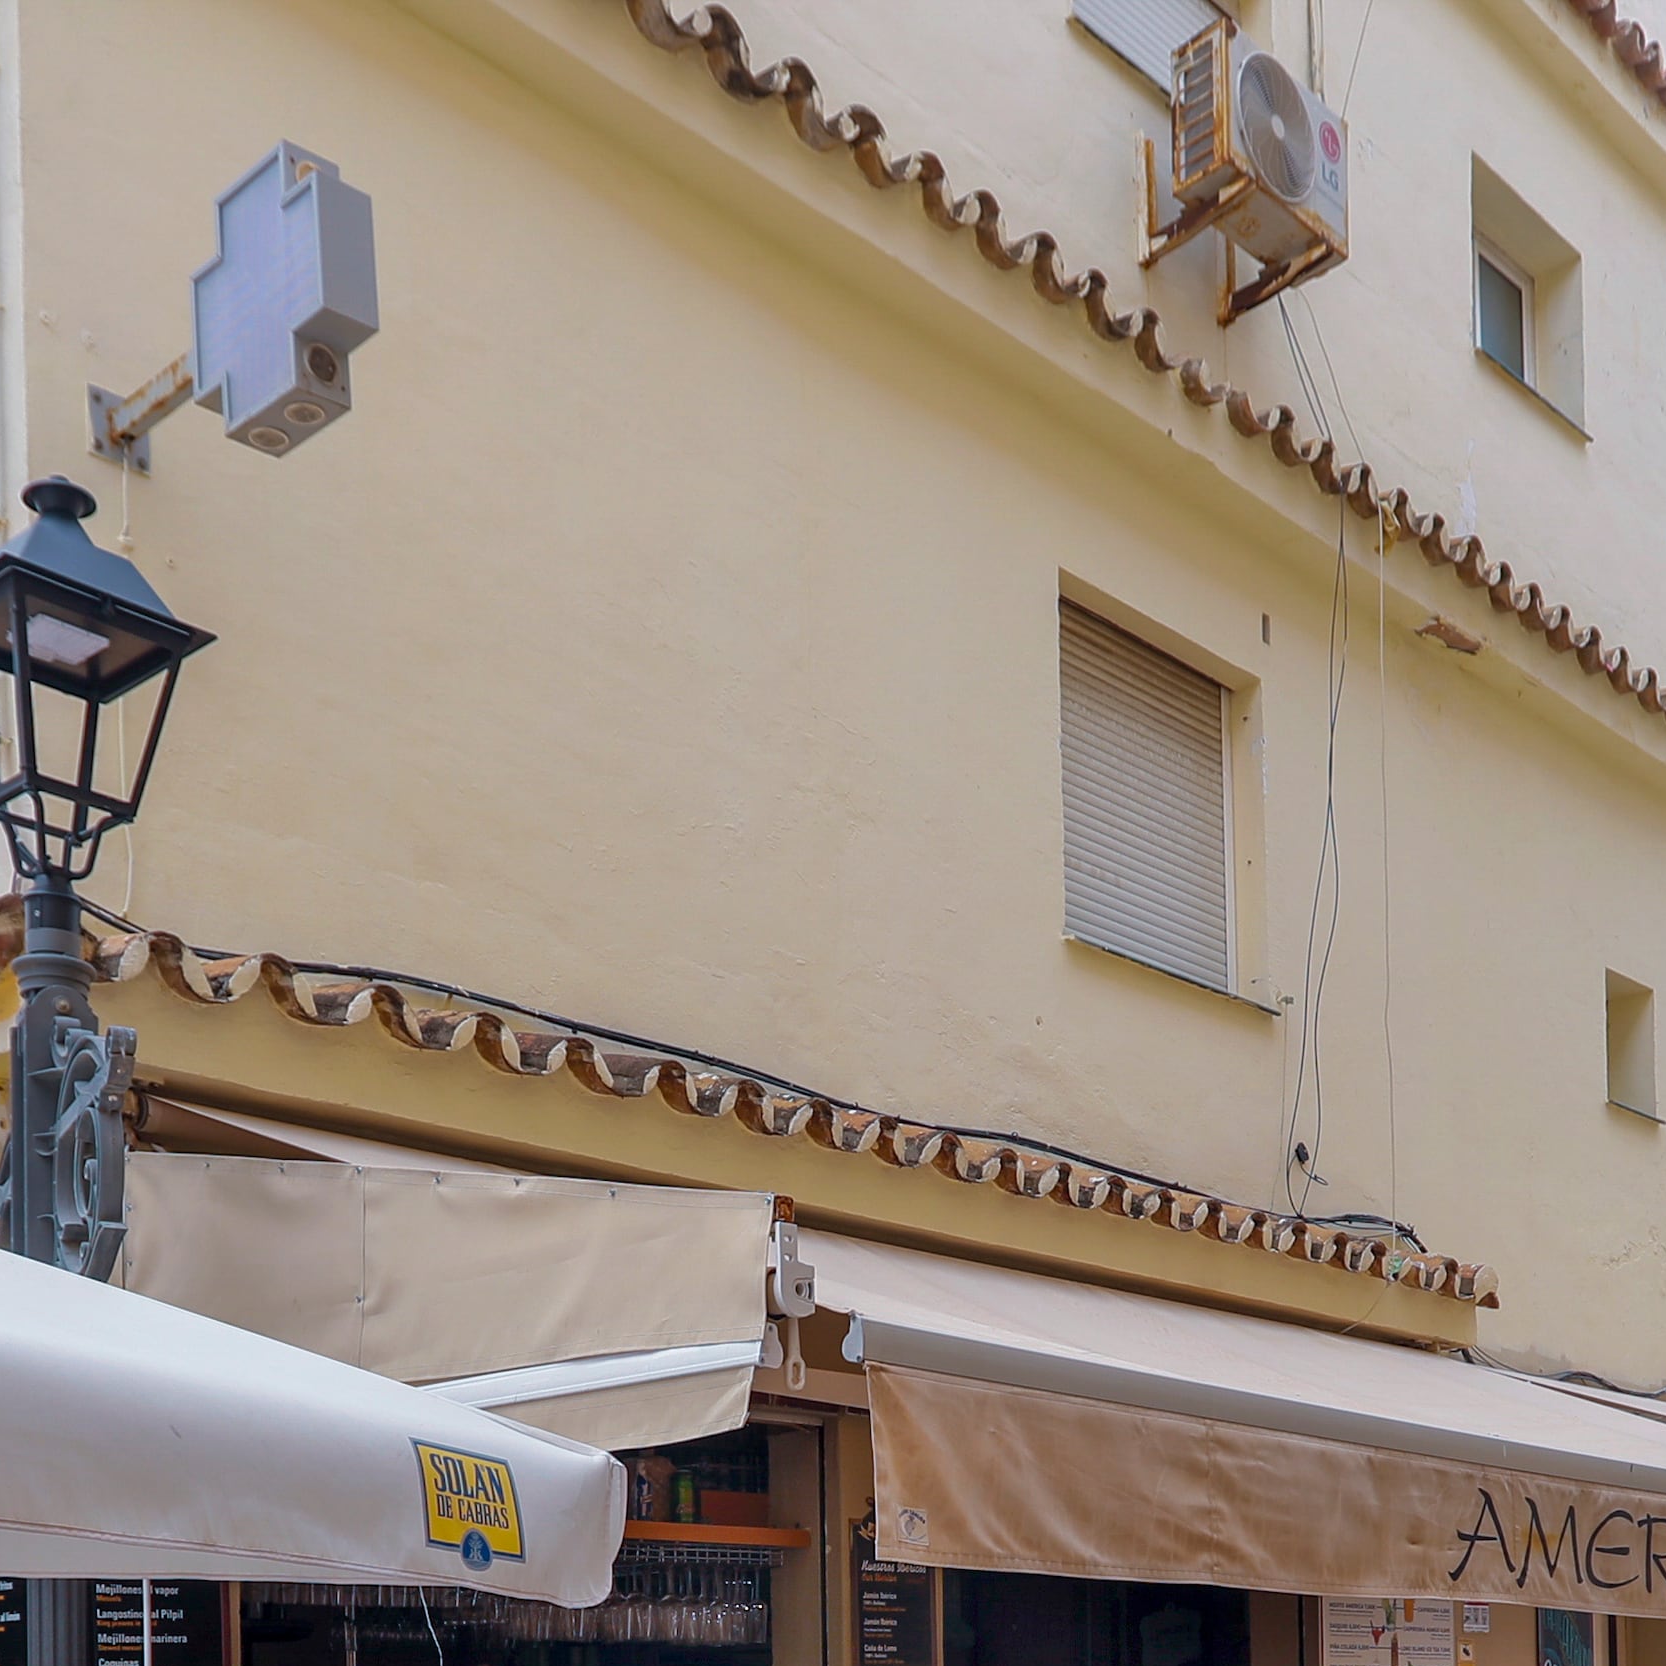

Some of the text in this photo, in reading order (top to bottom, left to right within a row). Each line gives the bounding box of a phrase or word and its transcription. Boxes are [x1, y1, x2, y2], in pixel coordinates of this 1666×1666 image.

[1321, 161, 1339, 192] LG
[436, 1494, 510, 1529] DE CABRAS
[96, 1584, 142, 1596] Mejillones
[154, 1587, 179, 1597] vapor
